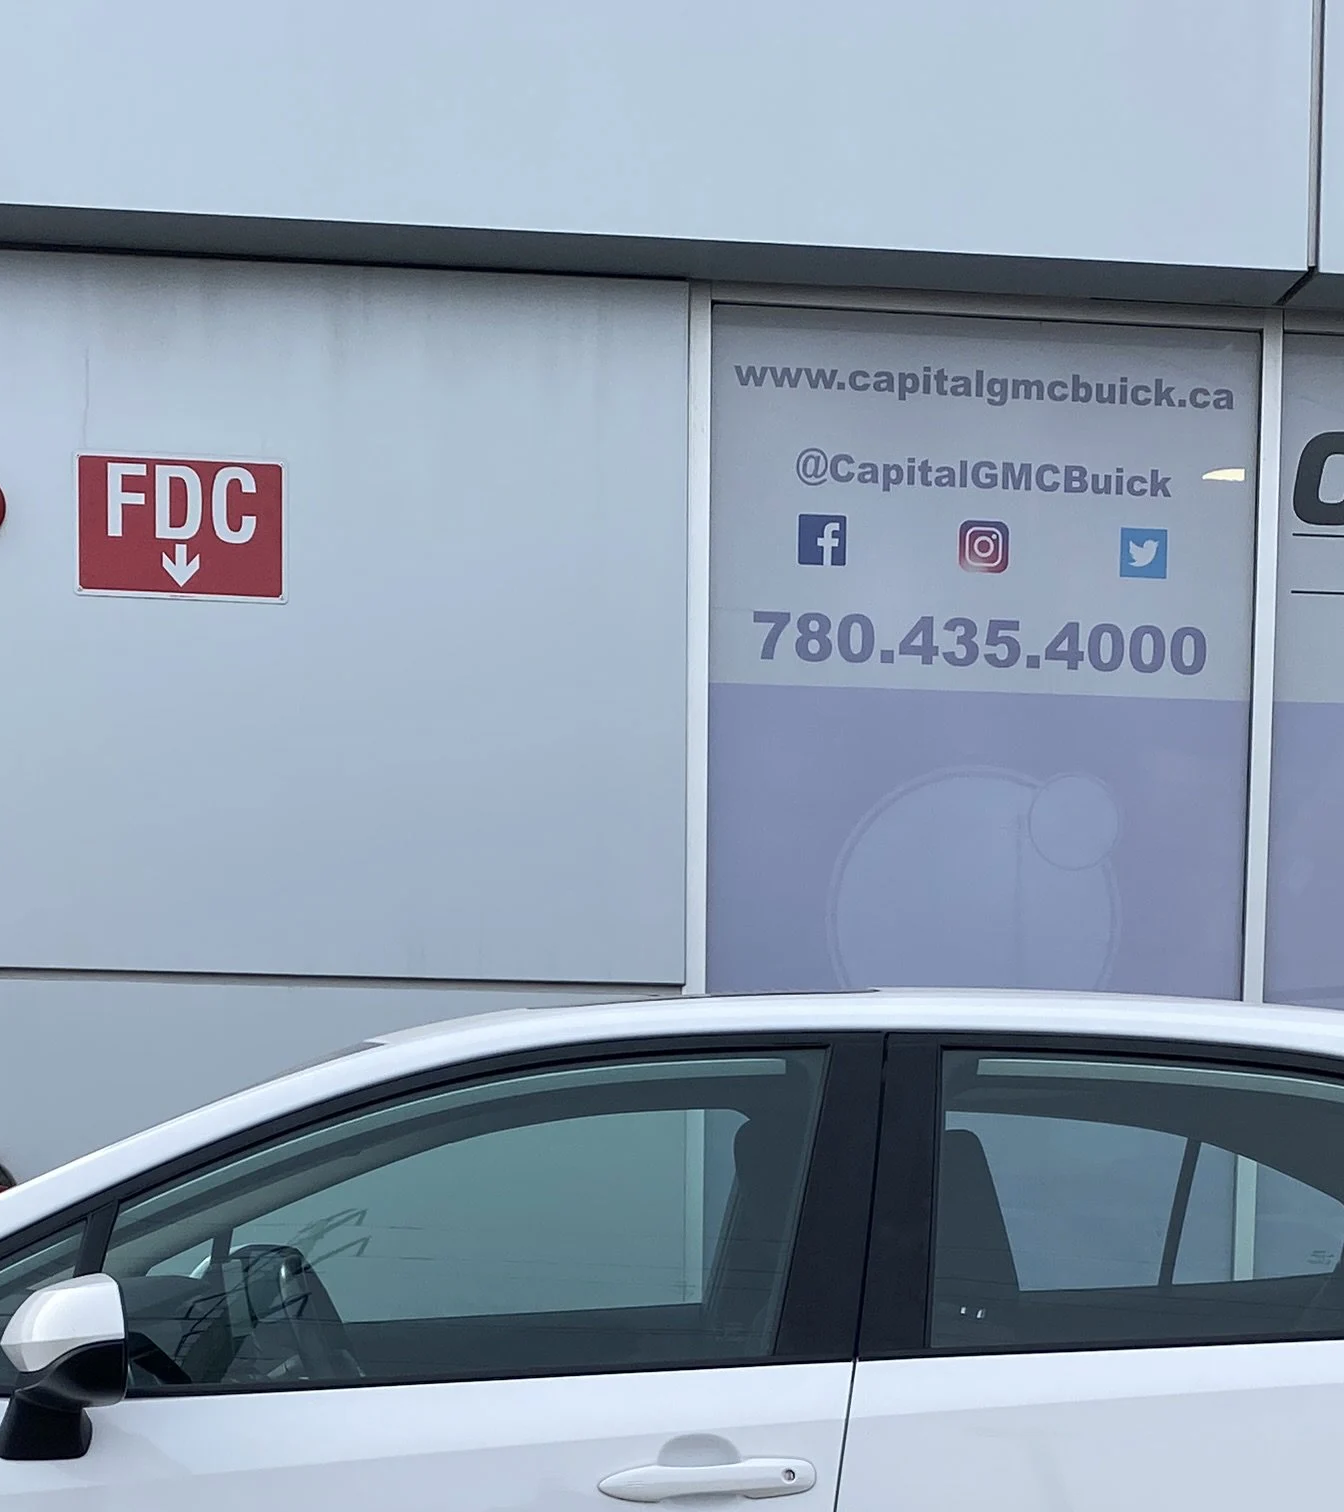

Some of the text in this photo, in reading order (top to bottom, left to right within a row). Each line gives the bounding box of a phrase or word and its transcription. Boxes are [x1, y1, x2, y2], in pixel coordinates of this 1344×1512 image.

[734, 363, 1235, 410] www.capitalgmcbuick.ca
[796, 447, 1172, 498] @CapitalGMCBuick
[106, 461, 257, 545] FDC
[752, 610, 1207, 676] 780.435.4000
